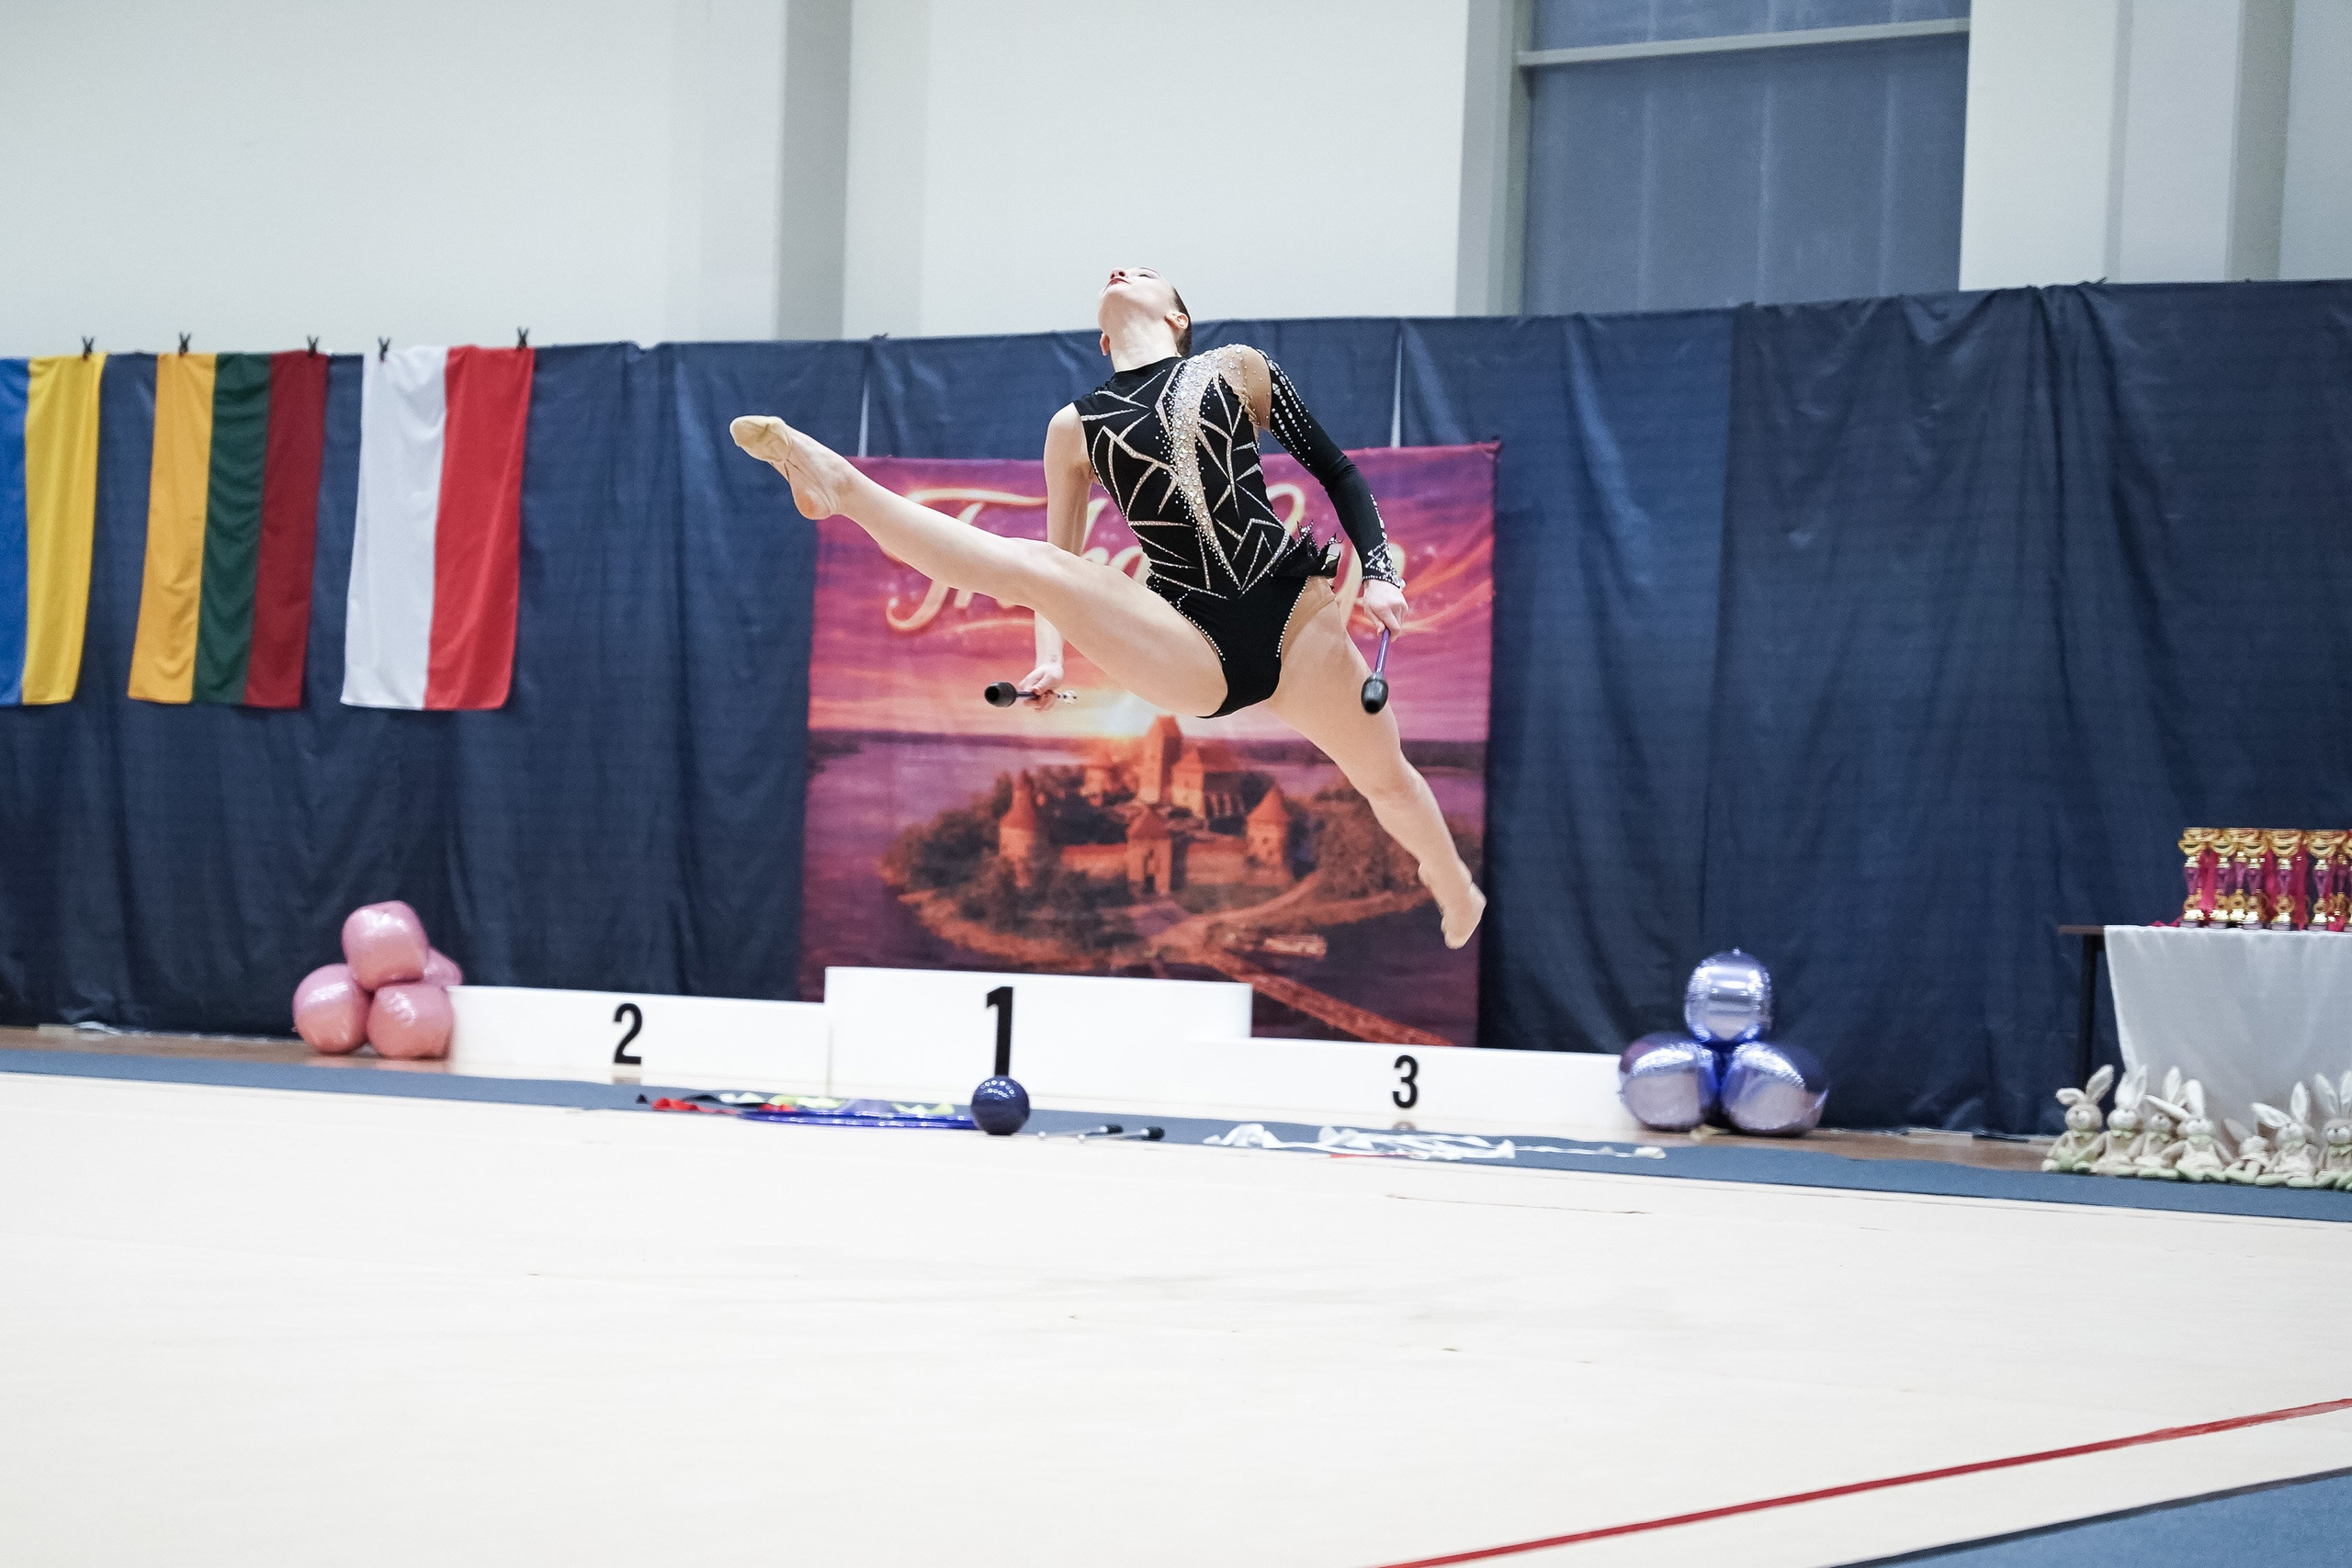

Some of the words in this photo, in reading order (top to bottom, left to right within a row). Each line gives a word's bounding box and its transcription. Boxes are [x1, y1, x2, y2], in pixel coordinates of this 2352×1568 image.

[614, 1002, 642, 1065] 2
[986, 986, 1013, 1077] 1
[1392, 1055, 1418, 1109] 3
